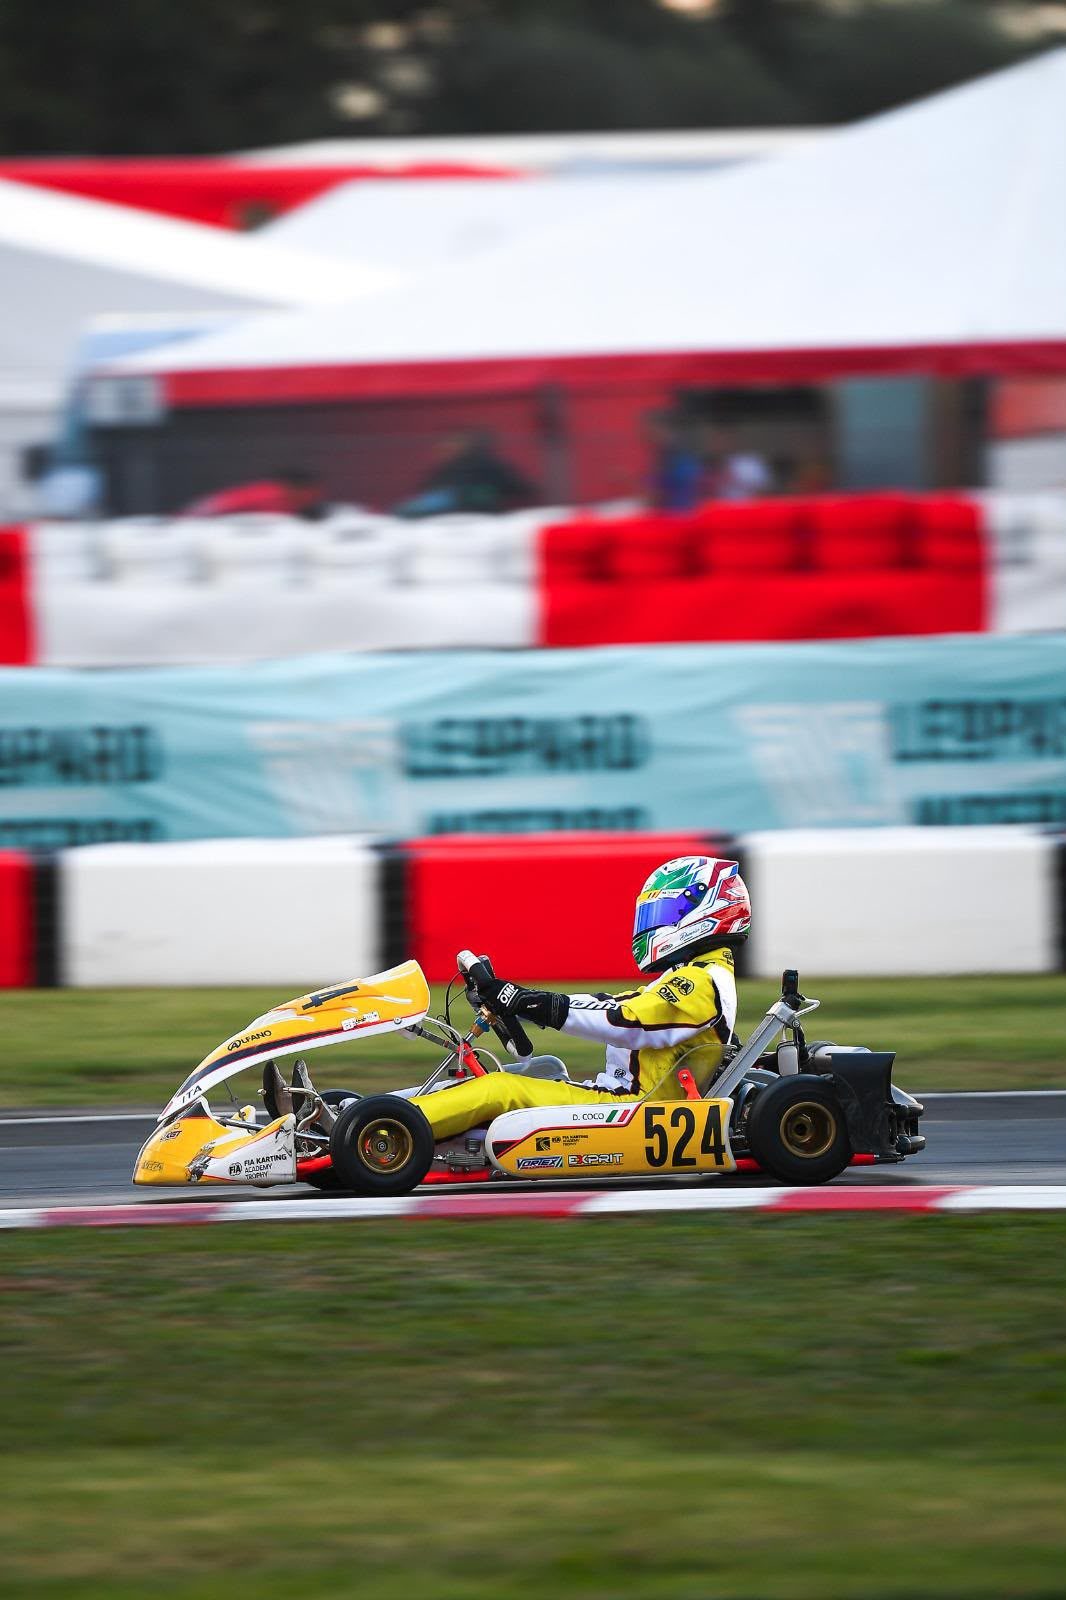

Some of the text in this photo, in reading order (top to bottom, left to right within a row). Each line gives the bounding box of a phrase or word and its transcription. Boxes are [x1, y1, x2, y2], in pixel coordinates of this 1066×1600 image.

[400, 714, 651, 778] LEOPARD
[500, 984, 516, 1004] OMP
[660, 987, 677, 1003] OMP
[227, 1030, 272, 1051] ALFANO
[182, 1085, 202, 1103] ITA
[645, 1104, 725, 1167] 524
[256, 1154, 287, 1164] KARTING
[517, 1157, 556, 1169] VORTEX
[568, 1153, 623, 1165] EXPRIT
[229, 1163, 242, 1175] FIA
[244, 1163, 272, 1173] ACADEMY
[245, 1171, 268, 1180] TROPHY
